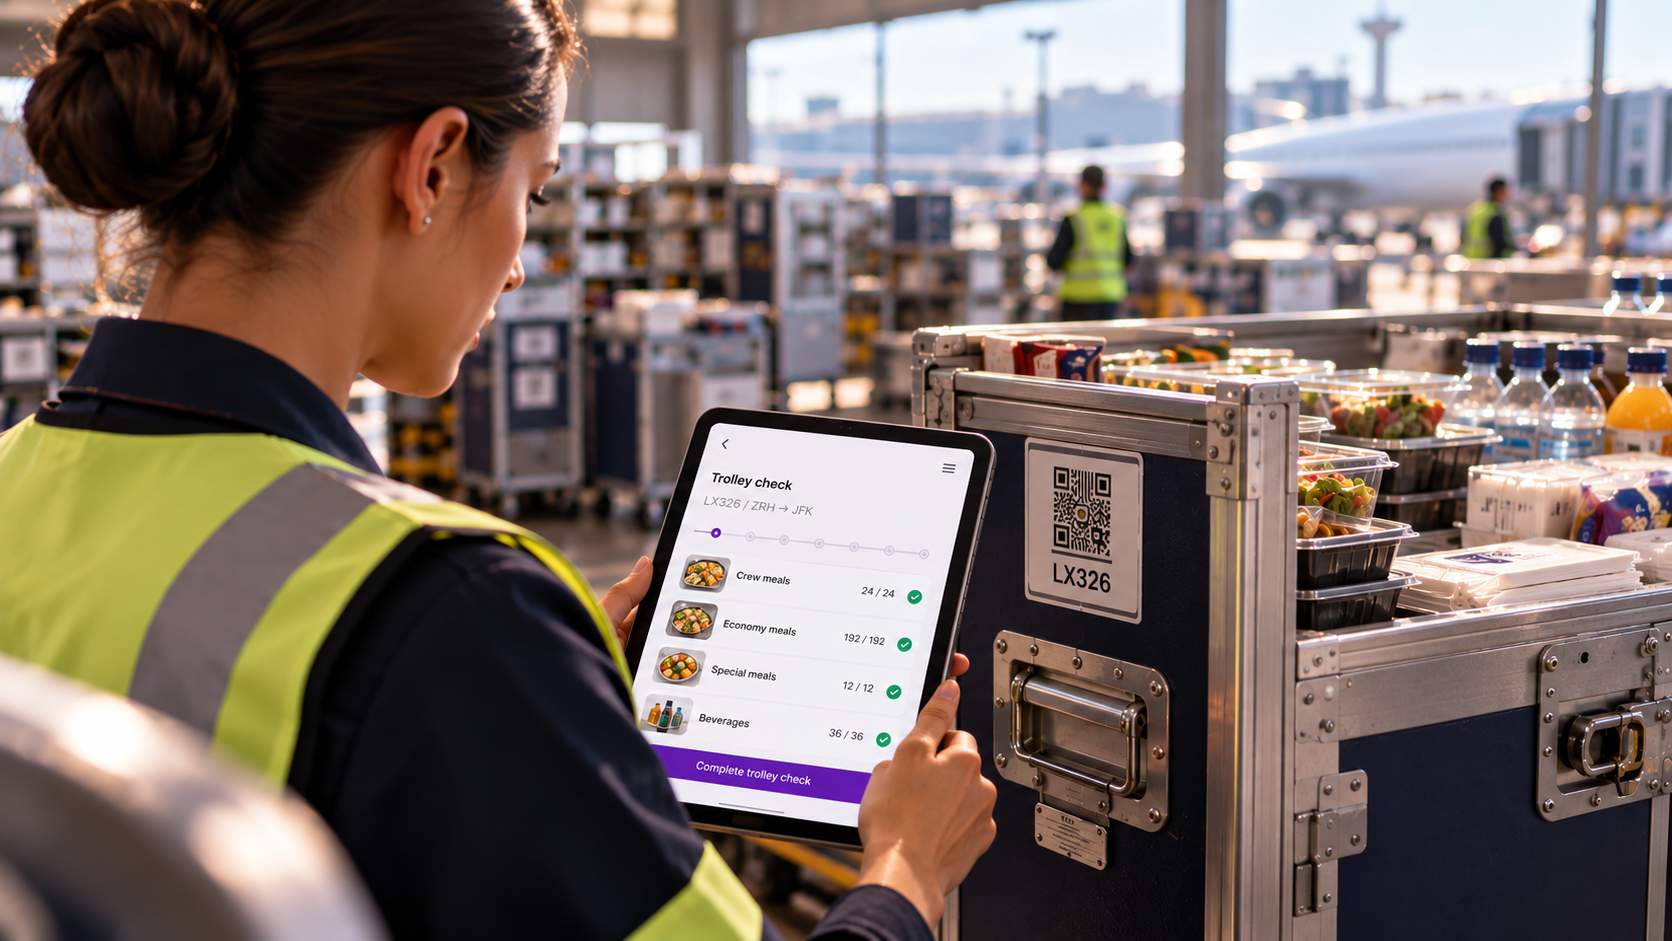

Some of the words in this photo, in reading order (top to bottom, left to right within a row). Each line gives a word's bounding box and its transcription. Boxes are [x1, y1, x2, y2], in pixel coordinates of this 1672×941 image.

[712, 472, 753, 488] Trolley
[755, 477, 792, 490] check
[704, 496, 741, 508] LX326
[742, 500, 750, 511] /
[751, 501, 776, 512] ZRH
[792, 505, 813, 516] JFK
[736, 571, 761, 581] Crew
[763, 576, 790, 585] meals
[1053, 562, 1111, 593] LX326
[861, 586, 873, 595] 24
[875, 588, 881, 597] /
[883, 589, 894, 598] 24
[723, 619, 767, 634] Economy
[769, 627, 796, 636] meals
[844, 633, 860, 643] 192
[861, 636, 867, 644] /
[869, 636, 885, 645] 192
[711, 665, 746, 677] Special
[748, 672, 776, 681] meals
[843, 681, 854, 690] 12
[855, 683, 861, 692] /
[863, 684, 874, 693] 12
[699, 714, 749, 728] Beverages
[829, 729, 842, 738] 36
[843, 731, 849, 740] /
[851, 731, 864, 741] 36
[696, 761, 744, 776] Complete
[747, 769, 778, 783] trolley
[780, 773, 811, 785] check
